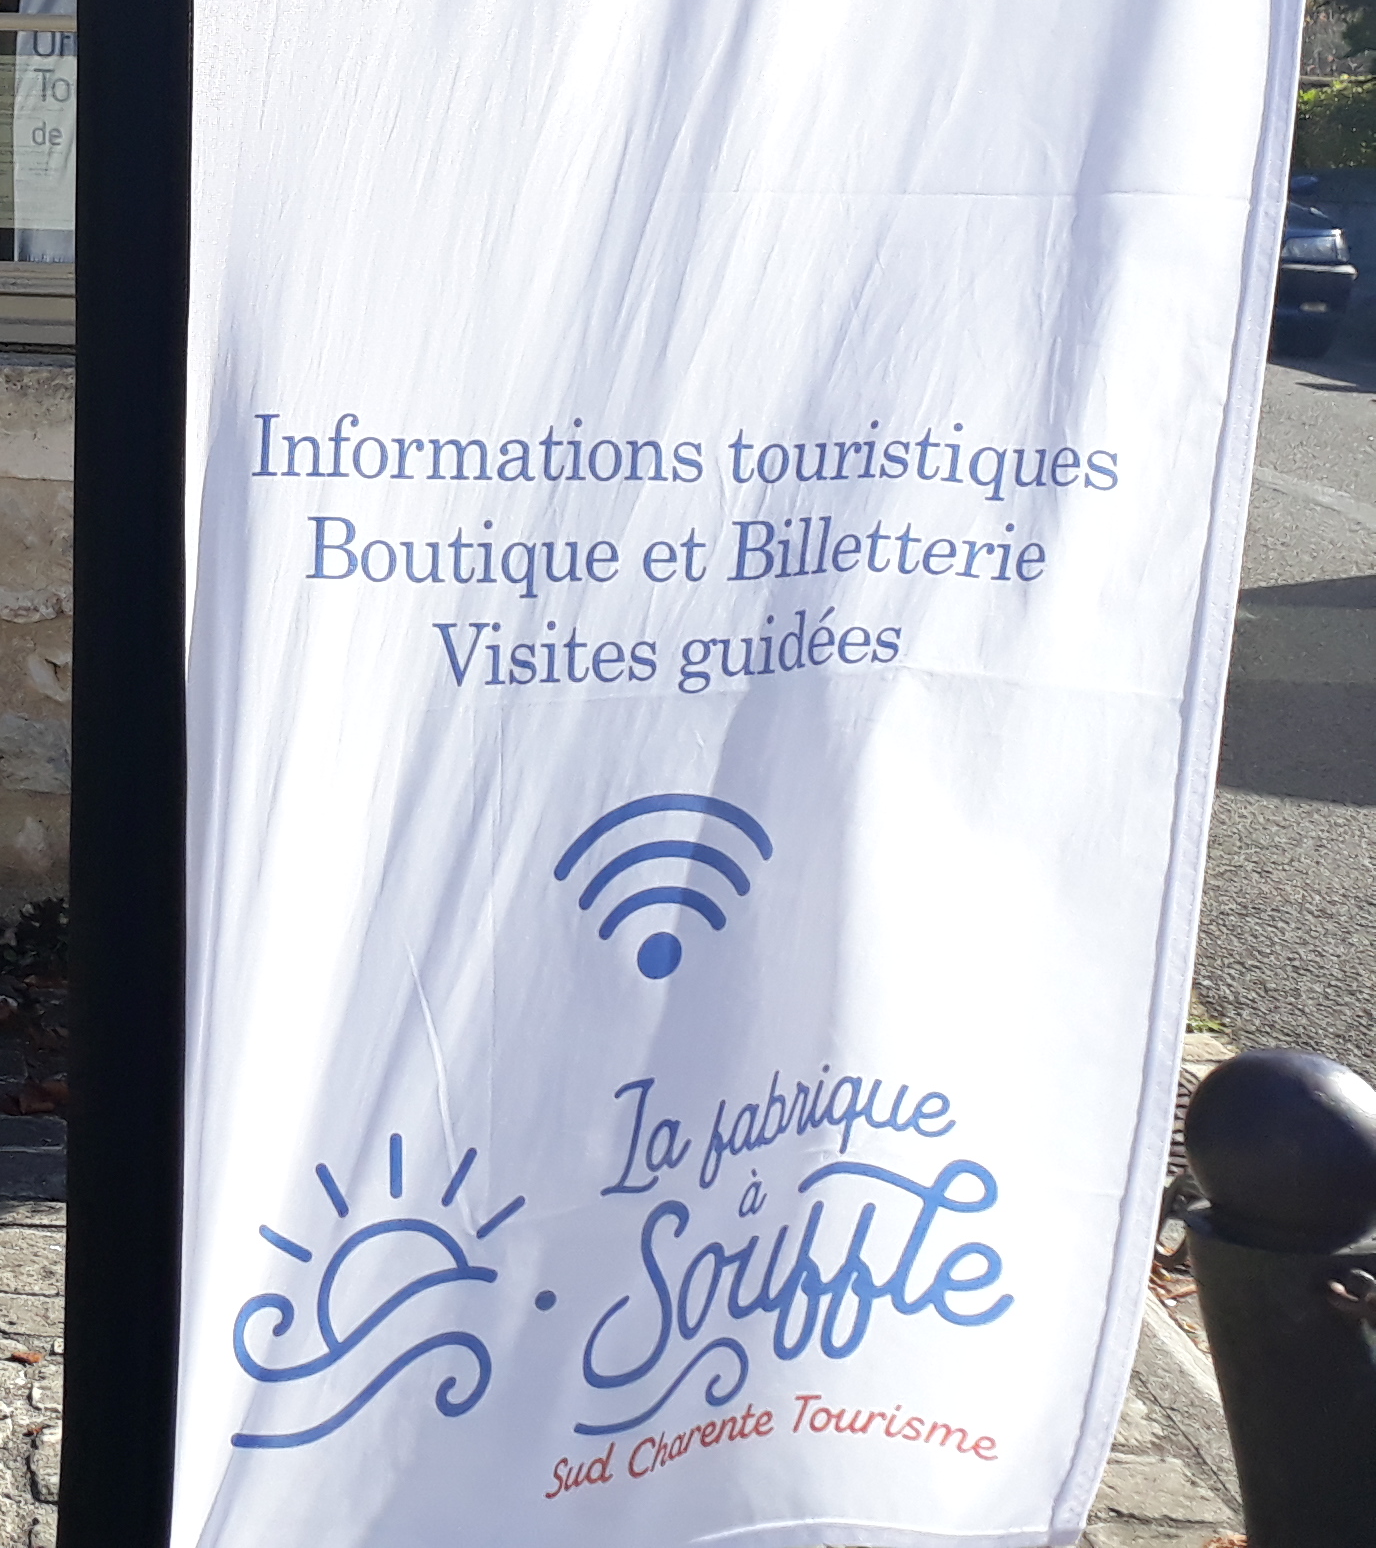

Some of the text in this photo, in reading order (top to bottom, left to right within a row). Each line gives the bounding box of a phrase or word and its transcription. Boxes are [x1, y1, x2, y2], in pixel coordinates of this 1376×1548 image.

[250, 411, 1120, 502] Informations touristiques
[305, 515, 1047, 600] Boutique et Billetterie
[431, 605, 902, 695] Visites guidées
[601, 1064, 958, 1196] La fabrique
[737, 1169, 767, 1218] à
[582, 1159, 1016, 1390] Souffle
[544, 1394, 999, 1500] Sud Charente Tourisme
